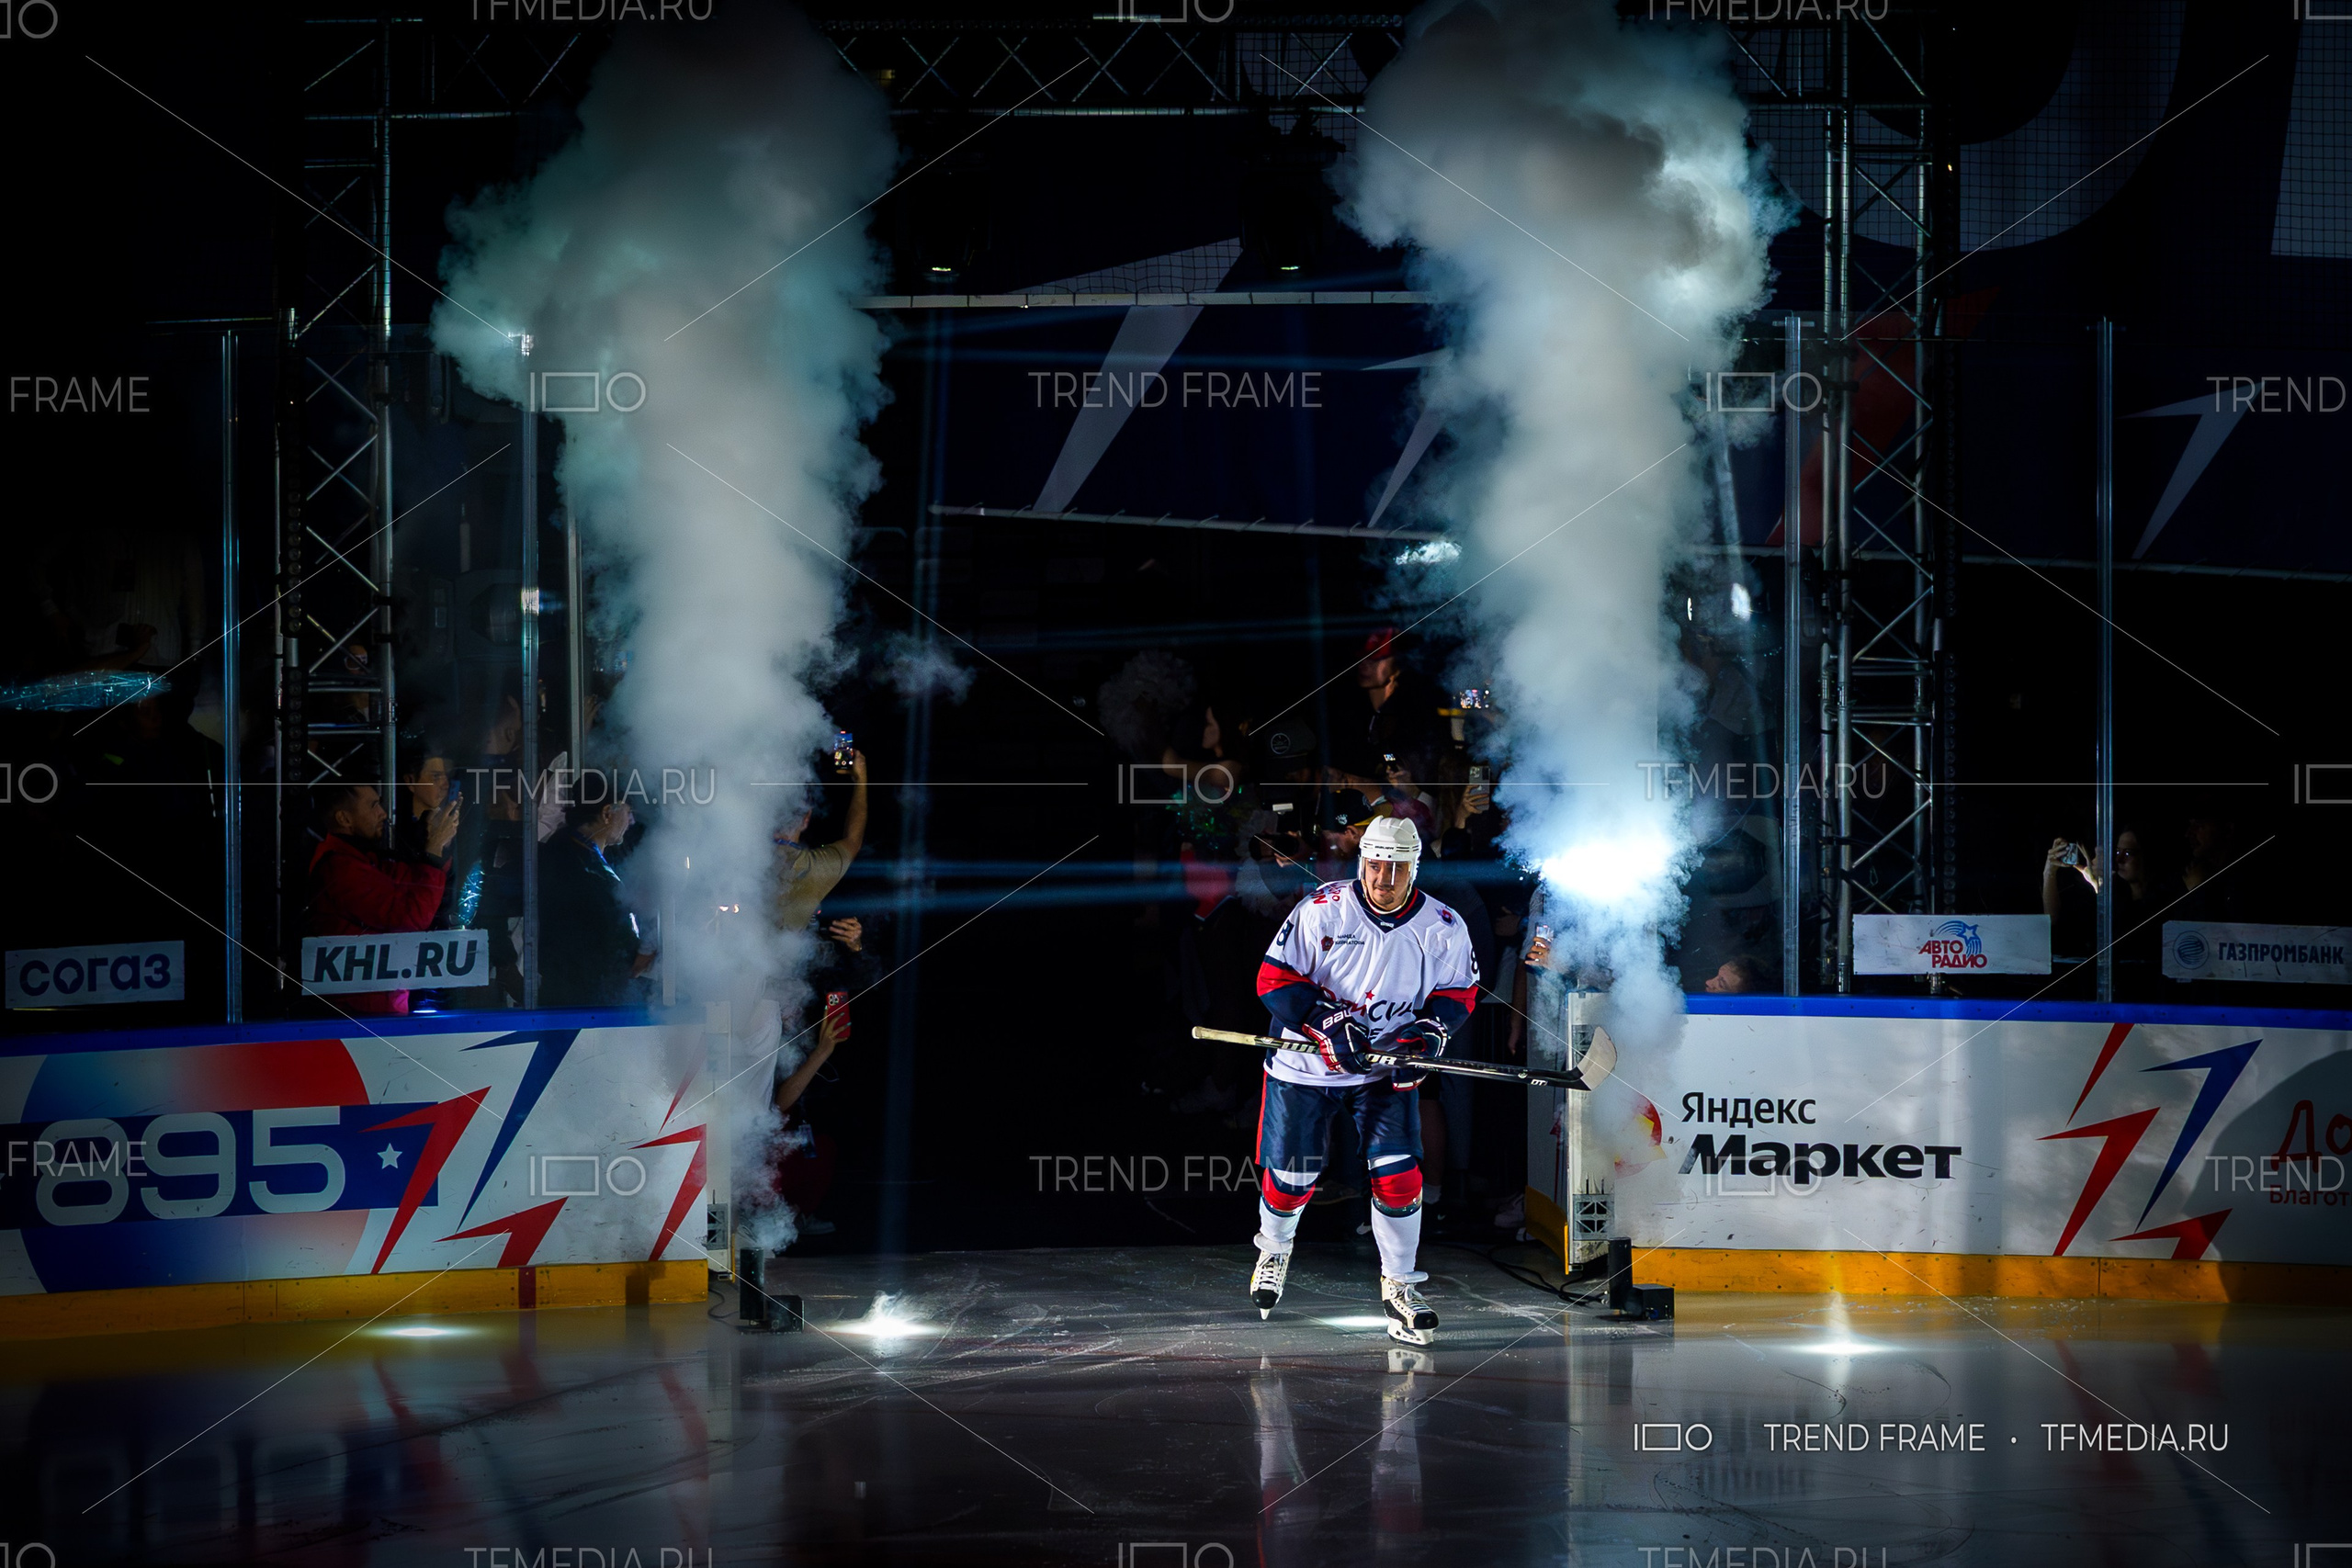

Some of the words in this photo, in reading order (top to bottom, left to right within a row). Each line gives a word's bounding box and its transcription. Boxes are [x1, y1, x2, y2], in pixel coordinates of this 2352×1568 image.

[313, 941, 478, 983] KHL.RU
[1918, 940, 1964, 954] АВТО
[1931, 954, 1988, 969] РАДИО
[2218, 942, 2345, 964] ГАЗПРОМБАНК
[1681, 1091, 1816, 1129] Яндекс
[36, 1105, 346, 1226] 895
[1678, 1134, 1962, 1185] Маркет
[2270, 1185, 2352, 1206] Благот
